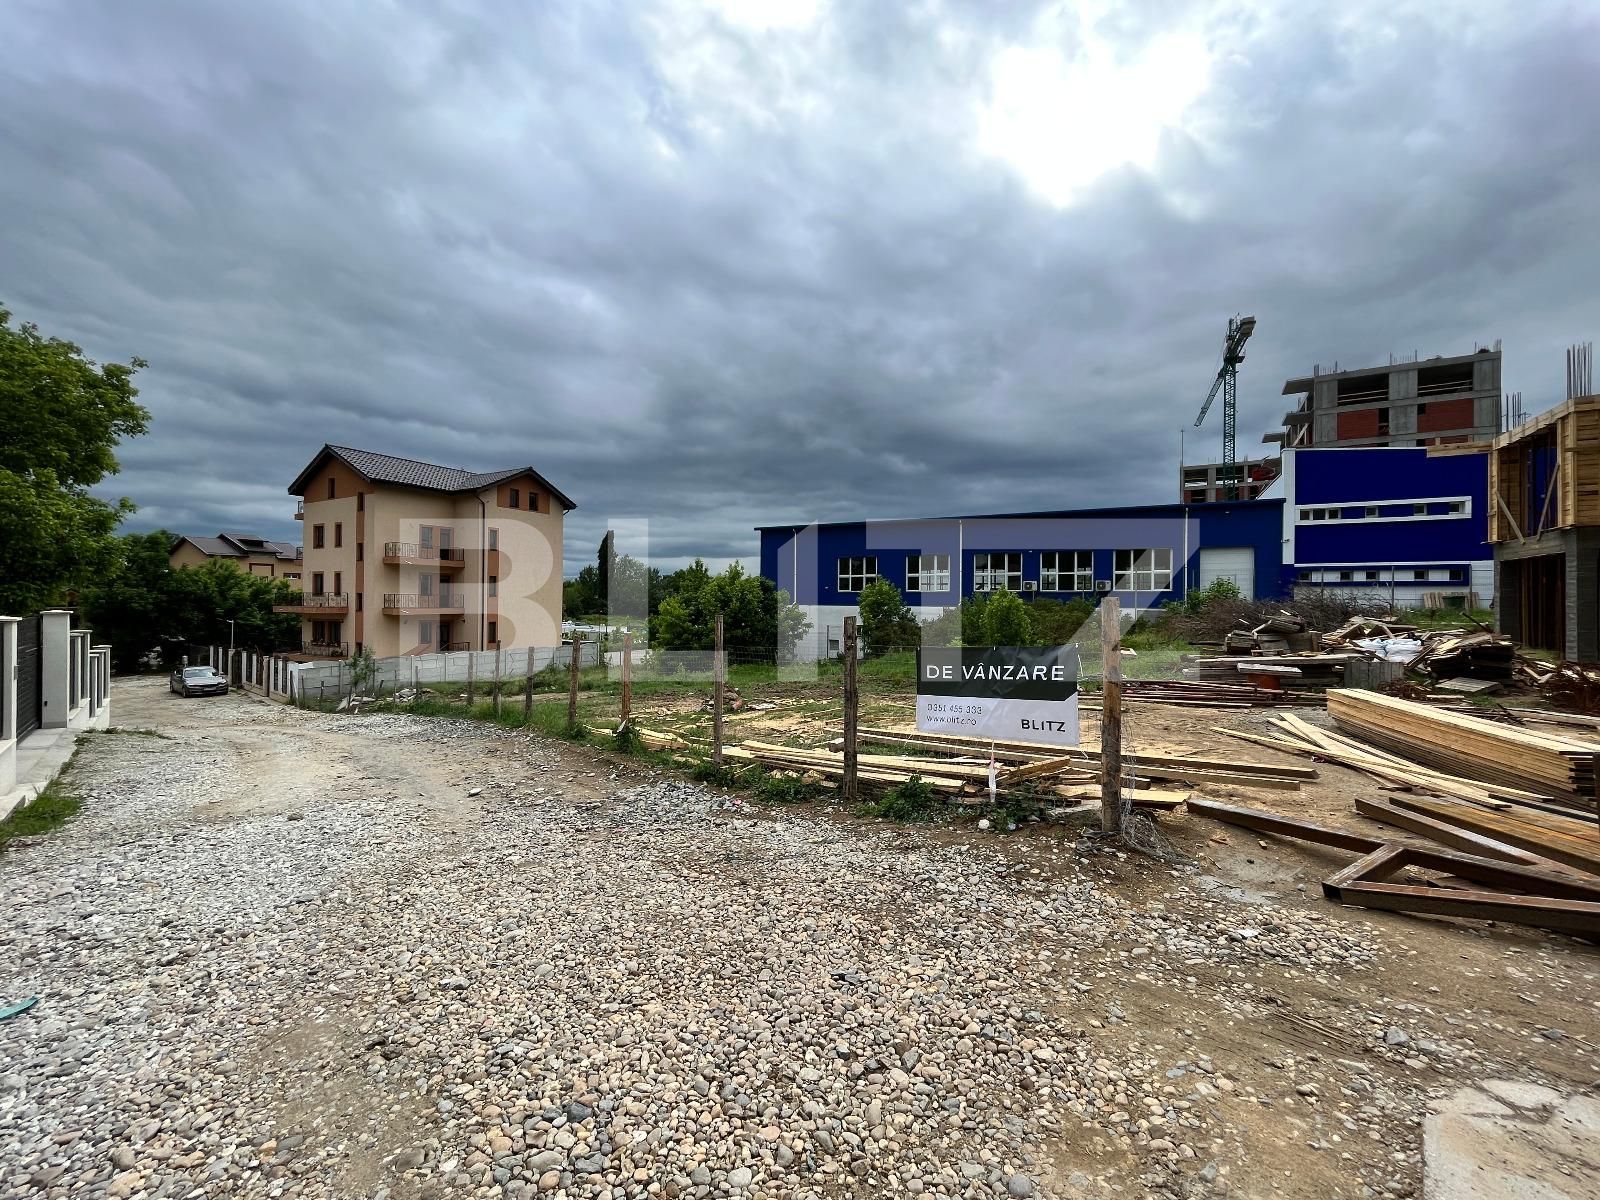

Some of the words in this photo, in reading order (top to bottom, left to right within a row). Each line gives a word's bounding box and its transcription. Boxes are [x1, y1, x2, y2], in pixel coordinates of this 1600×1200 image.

[926, 664, 953, 679] DE
[962, 663, 1065, 681] VÂNZARE
[1021, 718, 1066, 733] BLITZ
